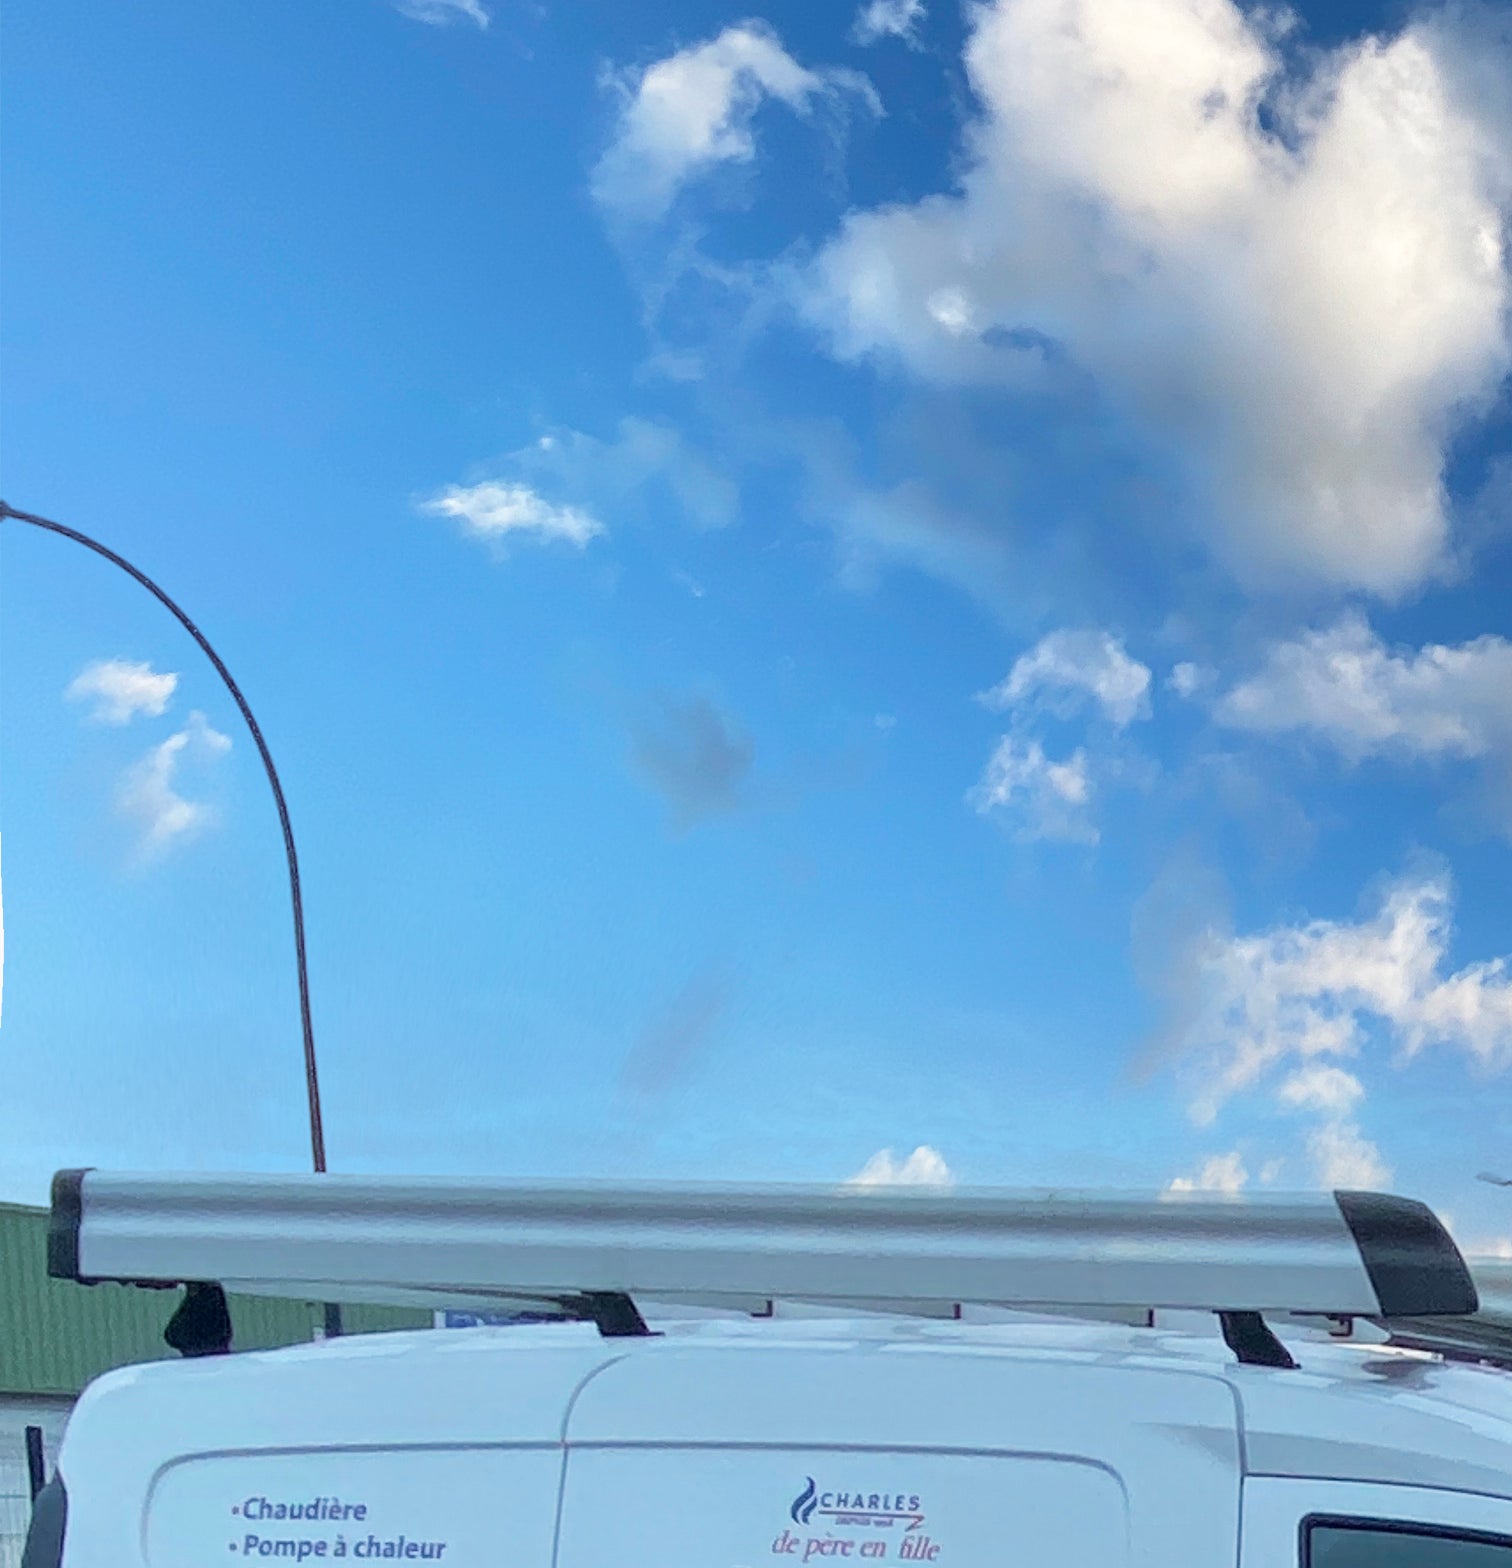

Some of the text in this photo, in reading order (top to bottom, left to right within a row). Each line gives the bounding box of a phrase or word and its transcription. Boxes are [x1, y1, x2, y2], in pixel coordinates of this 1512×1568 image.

[243, 1498, 367, 1521] Chaudière
[820, 1492, 921, 1512] CHARLES
[243, 1534, 447, 1562] Pompe à chaleur
[772, 1530, 941, 1564] de père en fille
